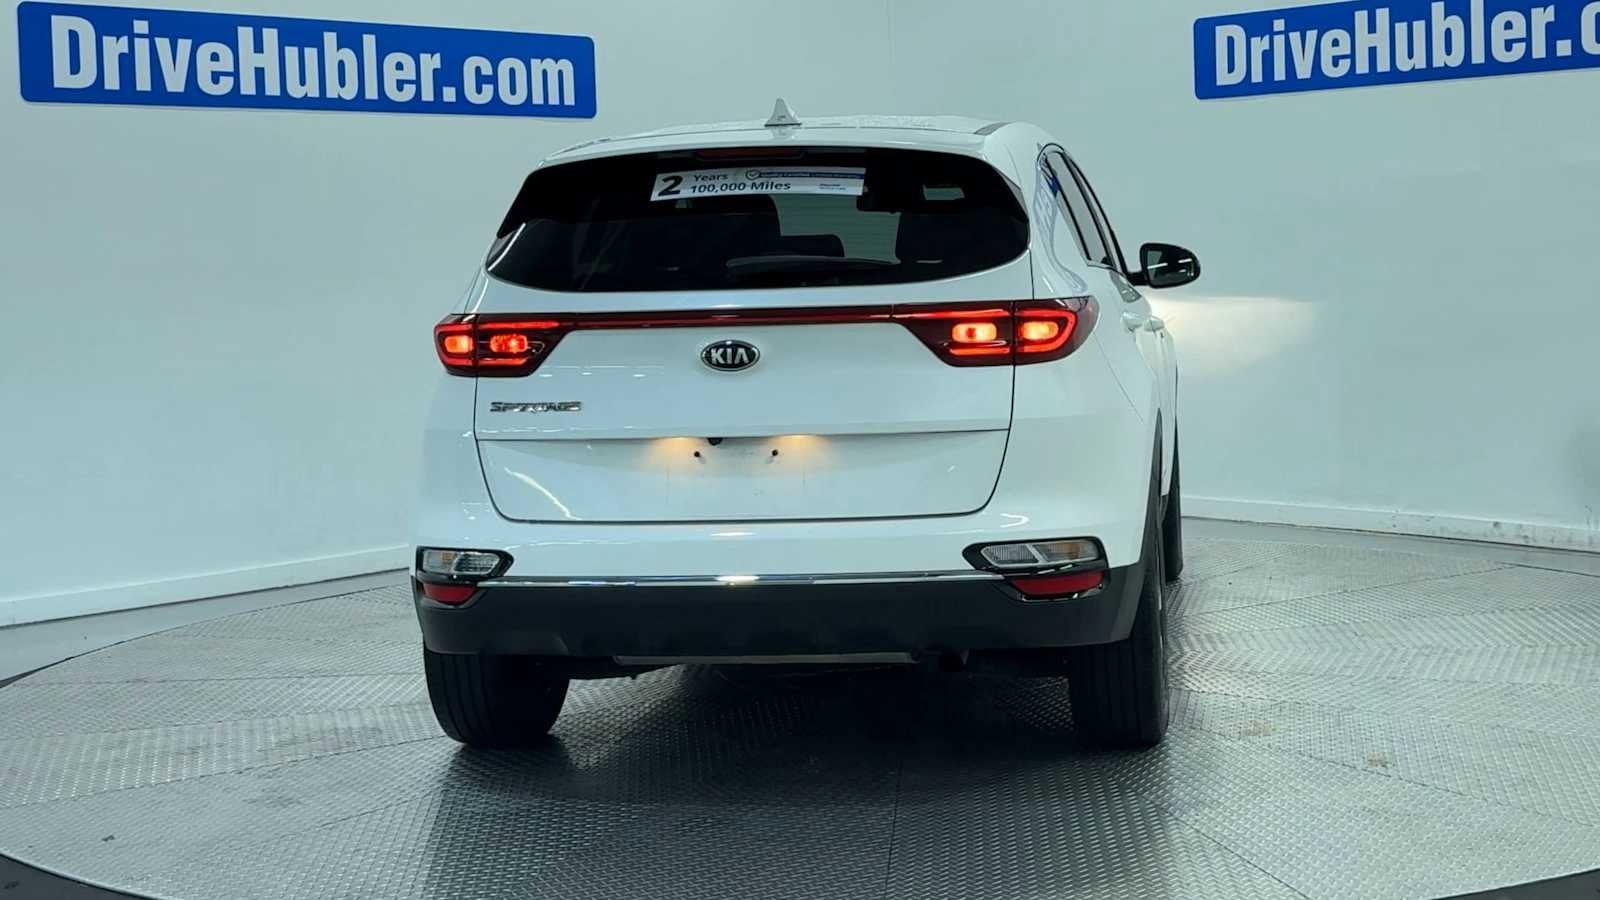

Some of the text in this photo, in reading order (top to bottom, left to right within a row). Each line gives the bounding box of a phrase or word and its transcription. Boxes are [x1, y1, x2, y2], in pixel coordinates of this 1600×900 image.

[51, 15, 576, 106] DriveHubler.com
[693, 173, 729, 181] Years
[658, 175, 683, 197] 2
[690, 181, 791, 194] 100,000 Miles
[711, 348, 750, 364] KIA
